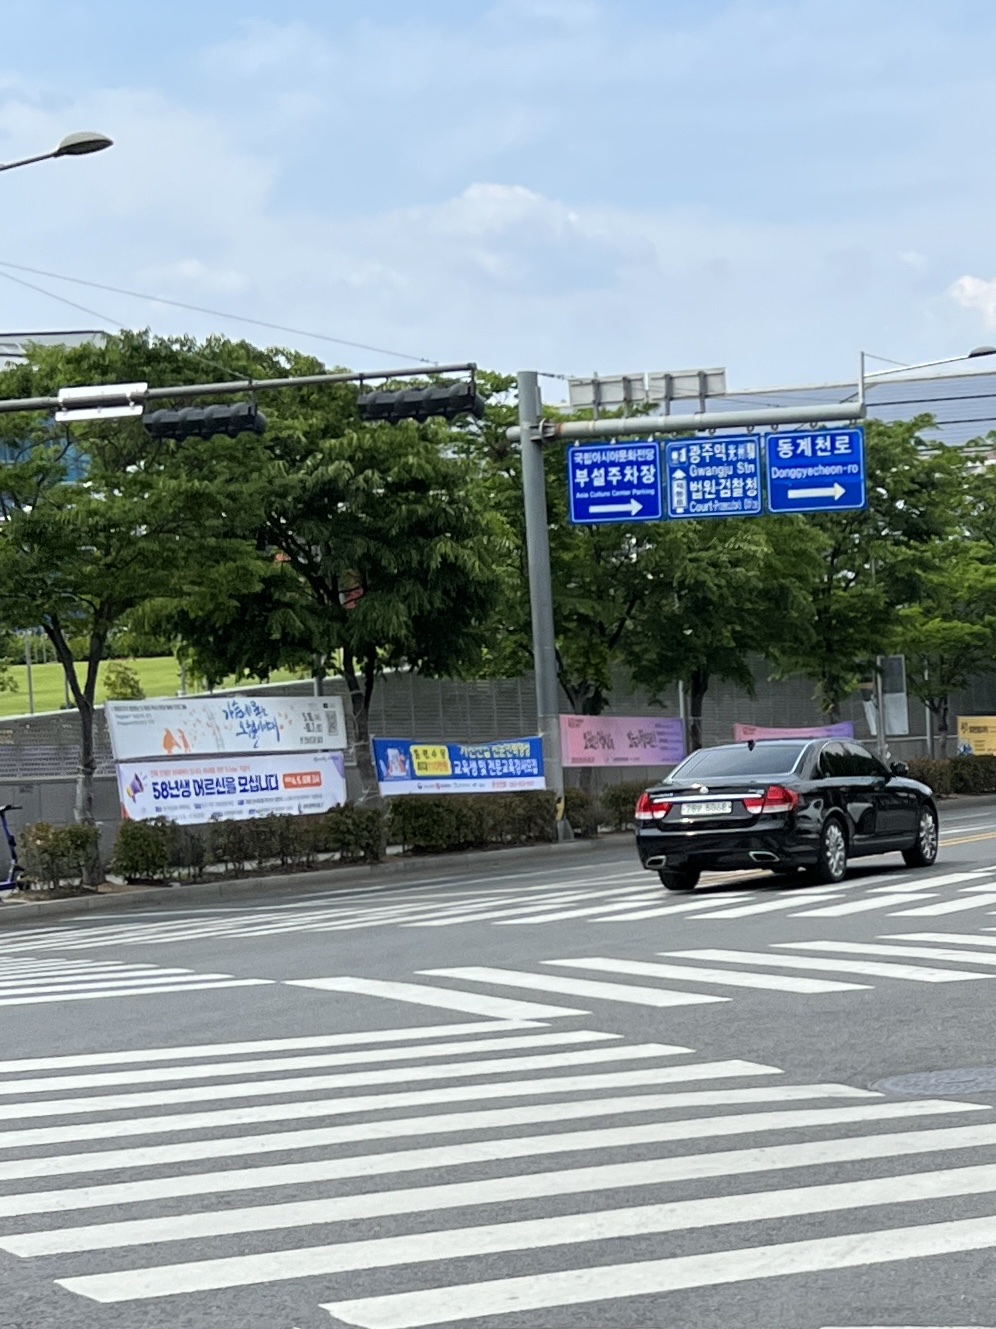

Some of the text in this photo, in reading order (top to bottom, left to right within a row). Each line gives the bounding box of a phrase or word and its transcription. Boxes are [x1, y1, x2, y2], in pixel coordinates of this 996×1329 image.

[777, 435, 852, 459] 동계천로
[574, 464, 656, 488] 부설주차장
[689, 463, 734, 478] Gwangju
[771, 464, 859, 479] Donggyecheon-ro
[152, 778, 192, 800] 58년생
[238, 773, 279, 793] 모십니다
